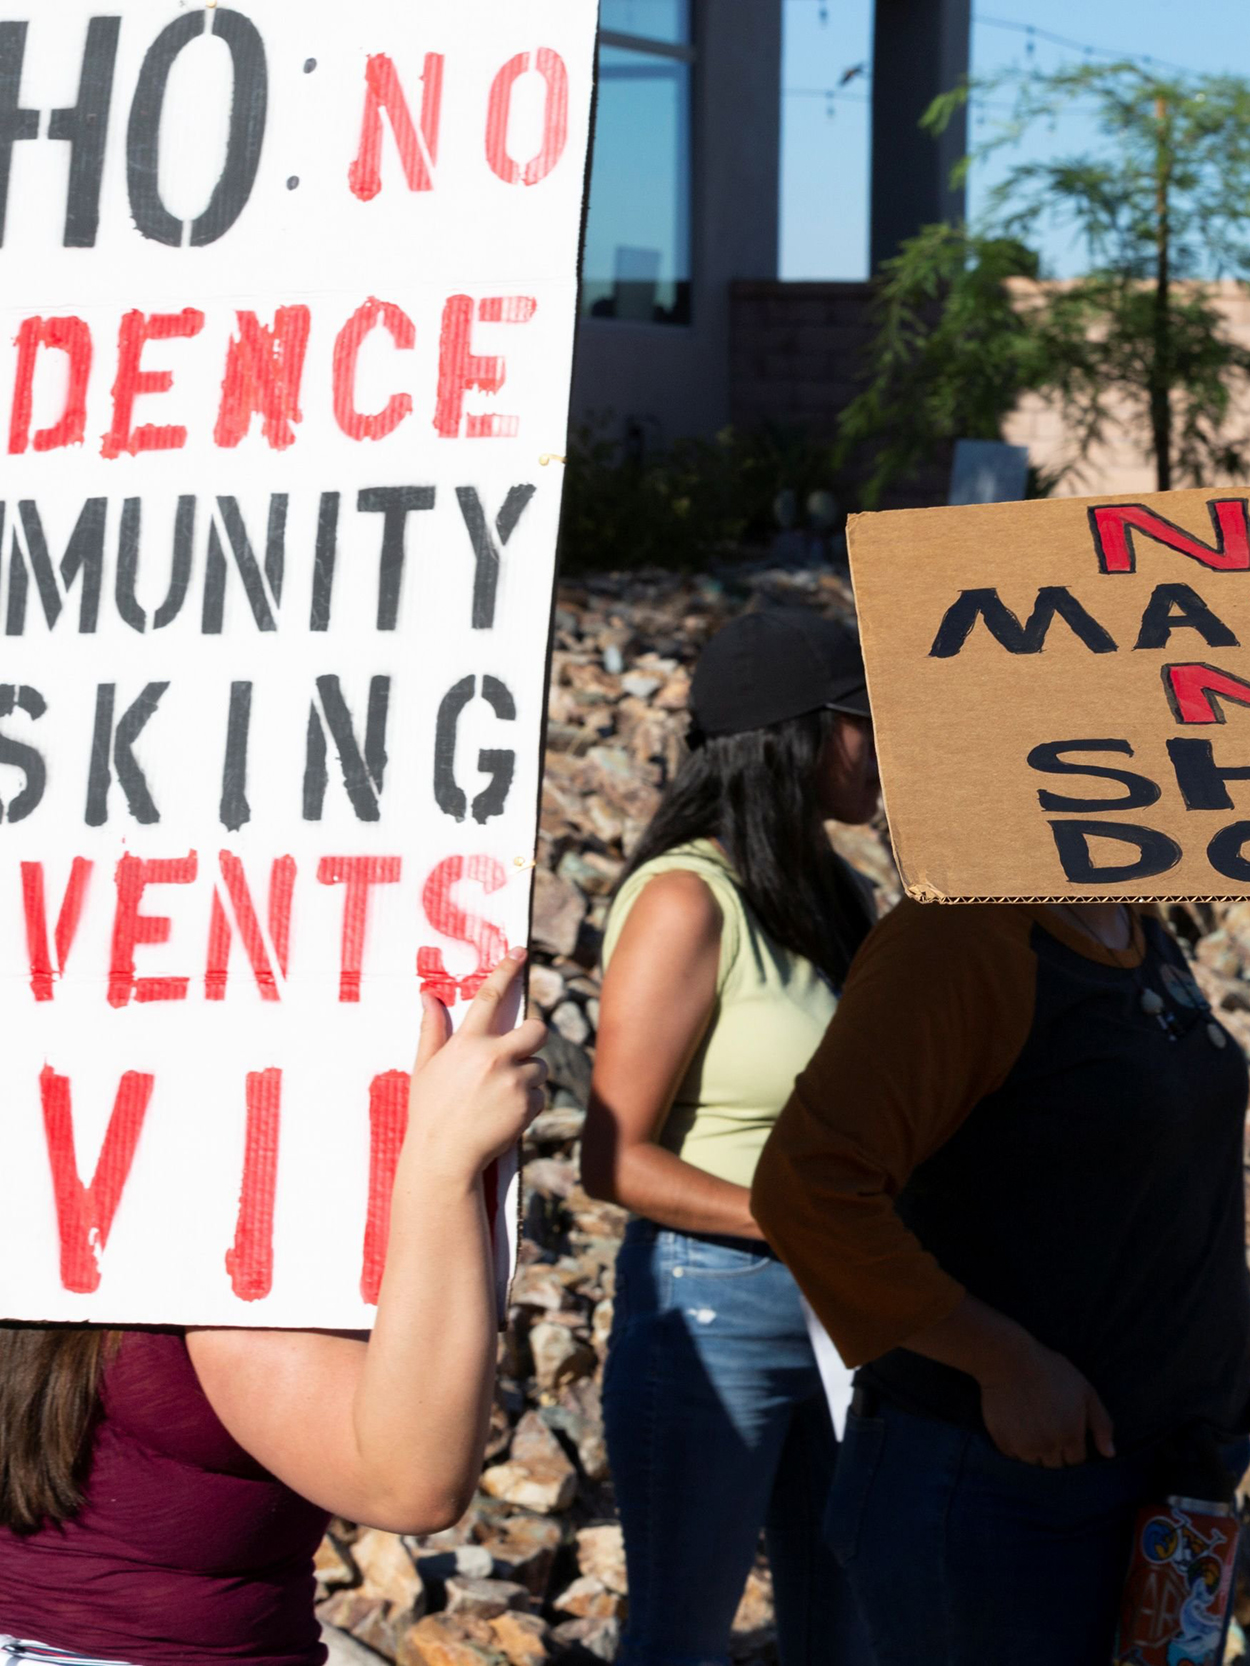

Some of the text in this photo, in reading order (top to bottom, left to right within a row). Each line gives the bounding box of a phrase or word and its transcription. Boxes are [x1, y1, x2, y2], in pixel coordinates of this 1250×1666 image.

[348, 46, 569, 203] NO
[0, 483, 538, 637] MUNITY
[19, 848, 509, 1009] VENTS
